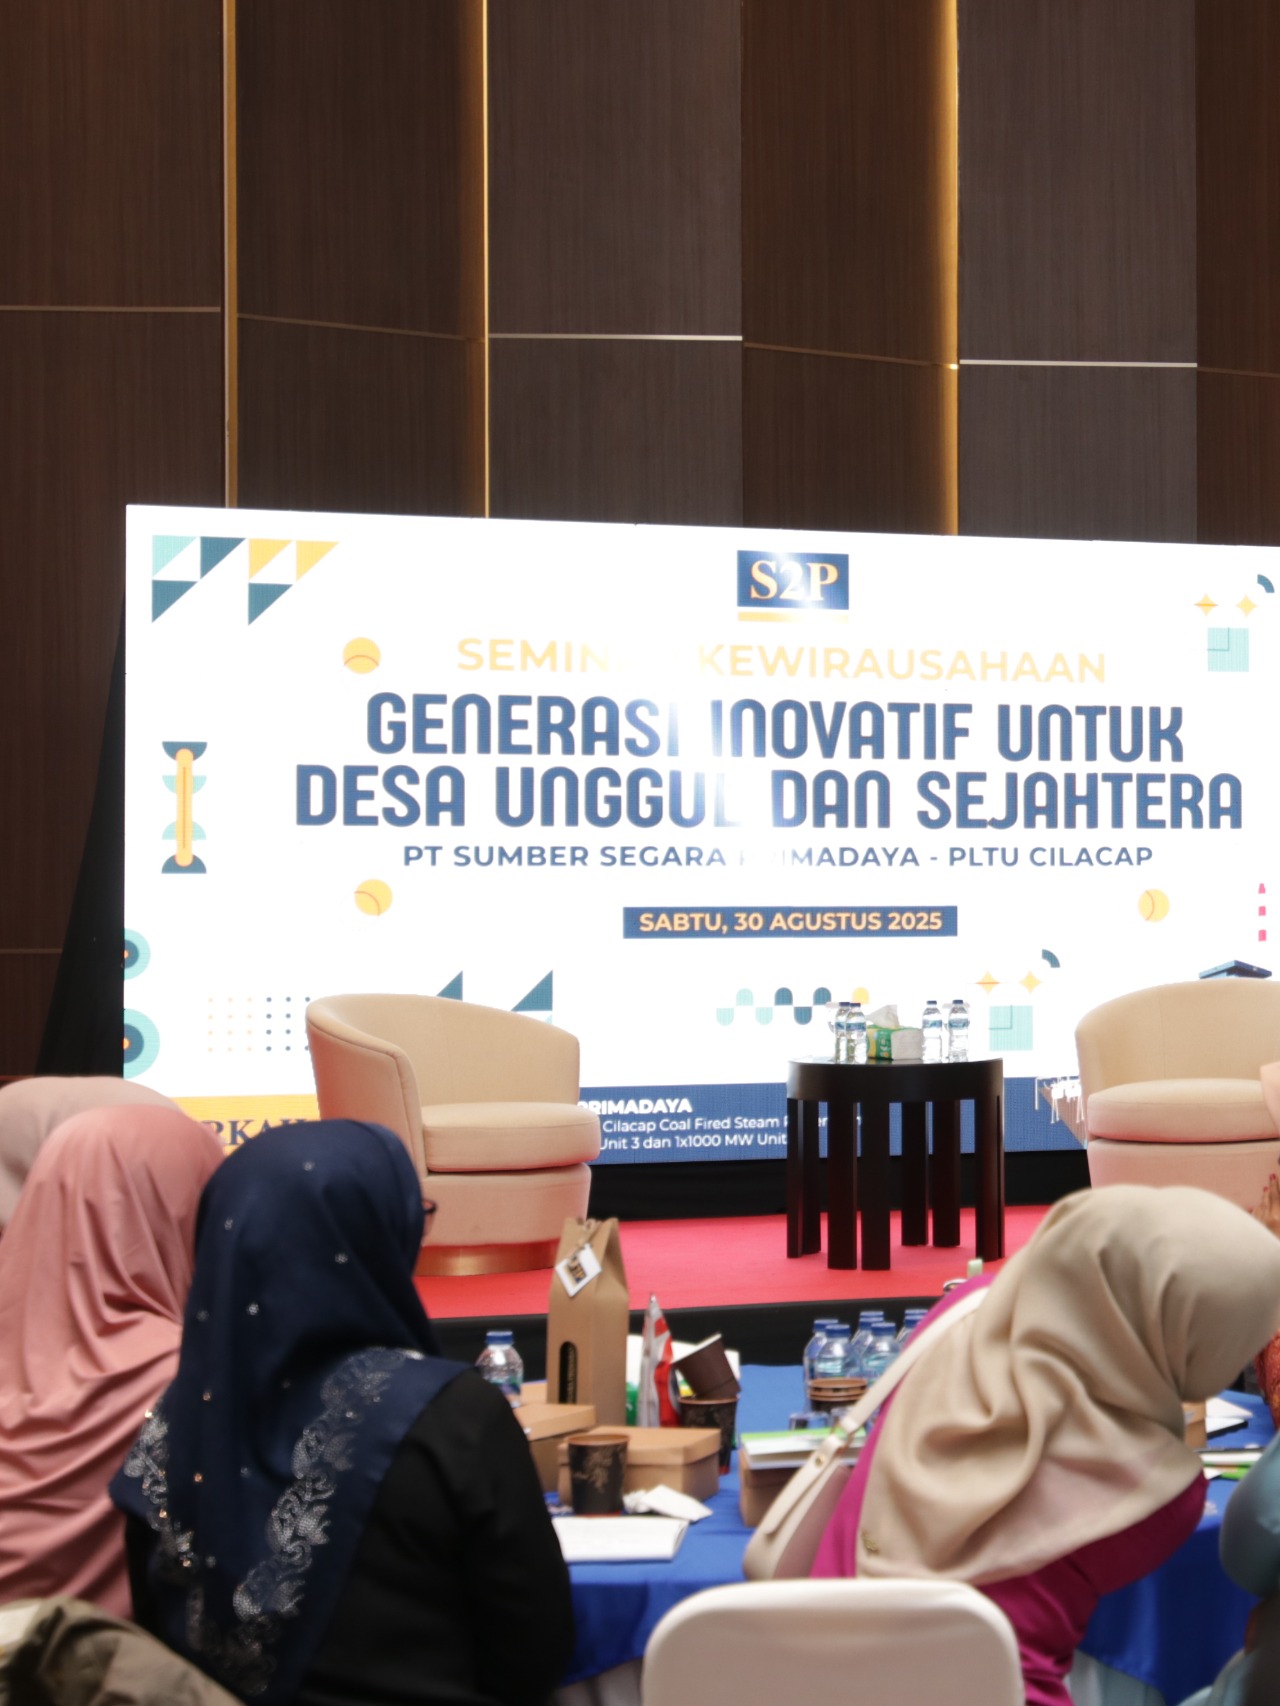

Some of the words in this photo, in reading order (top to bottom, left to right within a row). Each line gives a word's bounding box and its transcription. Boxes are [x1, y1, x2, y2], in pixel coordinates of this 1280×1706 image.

[750, 560, 839, 601] S2P
[457, 637, 640, 673] SEMIN
[698, 644, 1106, 683] KEWIRAUSAHAAN
[367, 692, 678, 757] GENERASI
[711, 698, 973, 760] INOVATIF
[998, 704, 1184, 763] UNTUK
[296, 764, 466, 827] DESA
[495, 766, 744, 828] UNGGUL
[771, 769, 891, 829] DAN
[917, 771, 1243, 830] SEJAHTERA
[403, 845, 443, 867] PT
[453, 845, 589, 868] SUMBER
[599, 845, 727, 868] SEGARA
[948, 846, 1019, 868] PLTU
[1029, 846, 1154, 868] CILACAP
[639, 912, 728, 934] SABTU,
[733, 912, 764, 932] 30
[769, 911, 882, 931] AGUSTUS
[887, 911, 943, 931] 2025
[602, 1119, 657, 1134] Cilacap
[658, 1118, 691, 1132] Coal
[694, 1117, 732, 1130] Fired
[733, 1116, 780, 1129] Steam
[630, 1136, 640, 1149] 3
[642, 1135, 672, 1149] dan
[674, 1133, 722, 1148] 1x1000
[724, 1133, 754, 1147] MW
[757, 1132, 787, 1146] Unit
